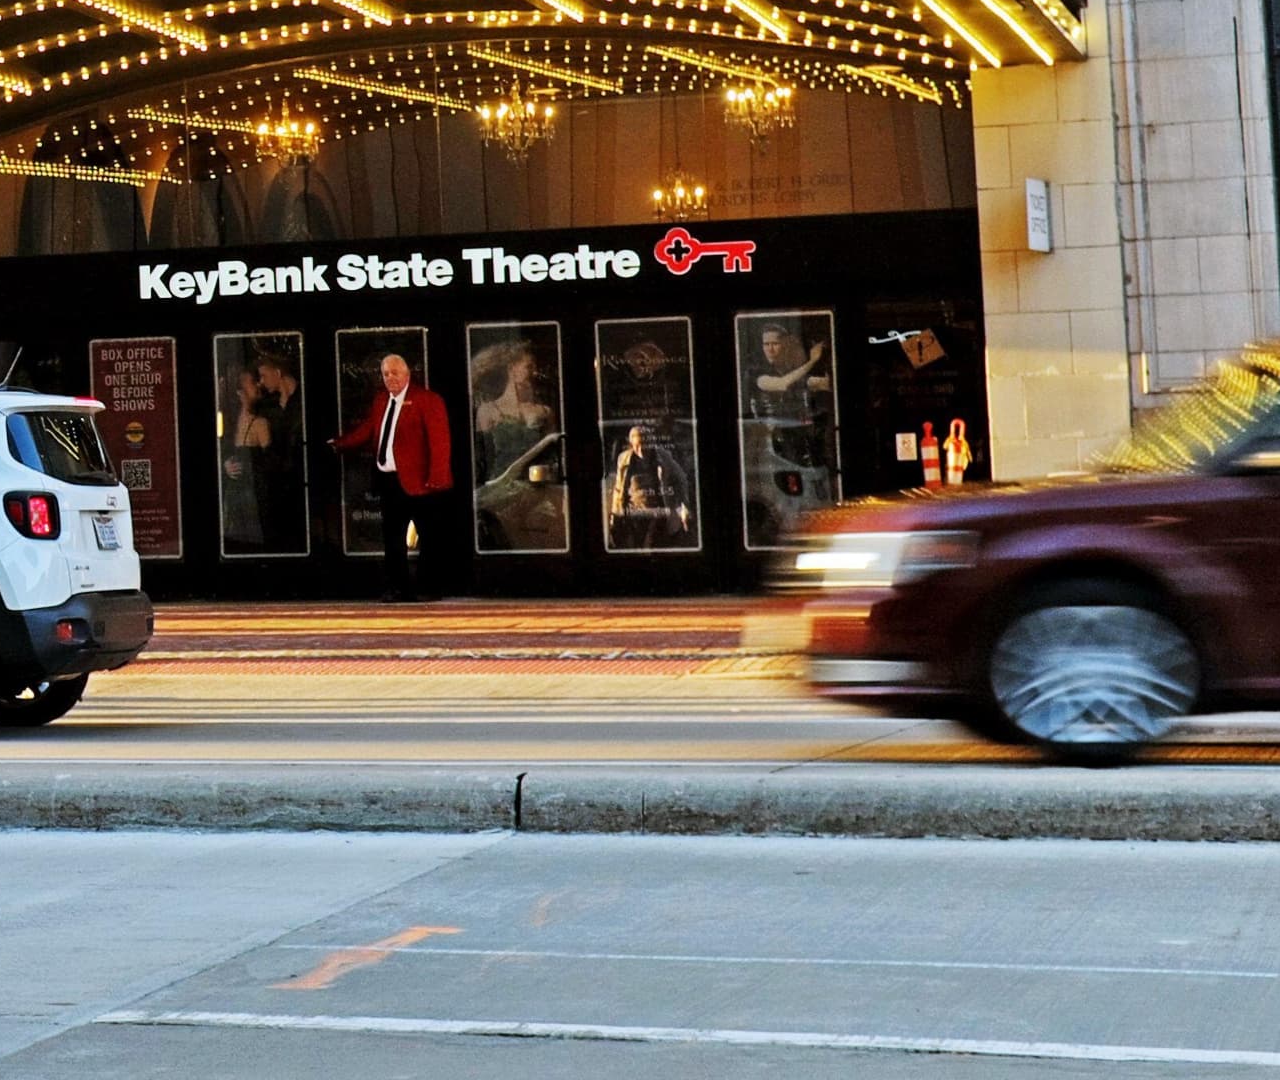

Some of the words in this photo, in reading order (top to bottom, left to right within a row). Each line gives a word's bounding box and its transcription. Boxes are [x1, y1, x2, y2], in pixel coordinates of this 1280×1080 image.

[139, 256, 330, 305] KeyBank
[337, 253, 454, 291] State
[462, 244, 640, 284] Theatre
[101, 349, 123, 361] BOX
[127, 347, 164, 360] OFFICE
[114, 360, 152, 373] OPENS
[105, 373, 127, 386] ONE
[131, 372, 162, 386] HOUR
[113, 386, 154, 399] BEFORE
[113, 398, 155, 412] SHOWS
